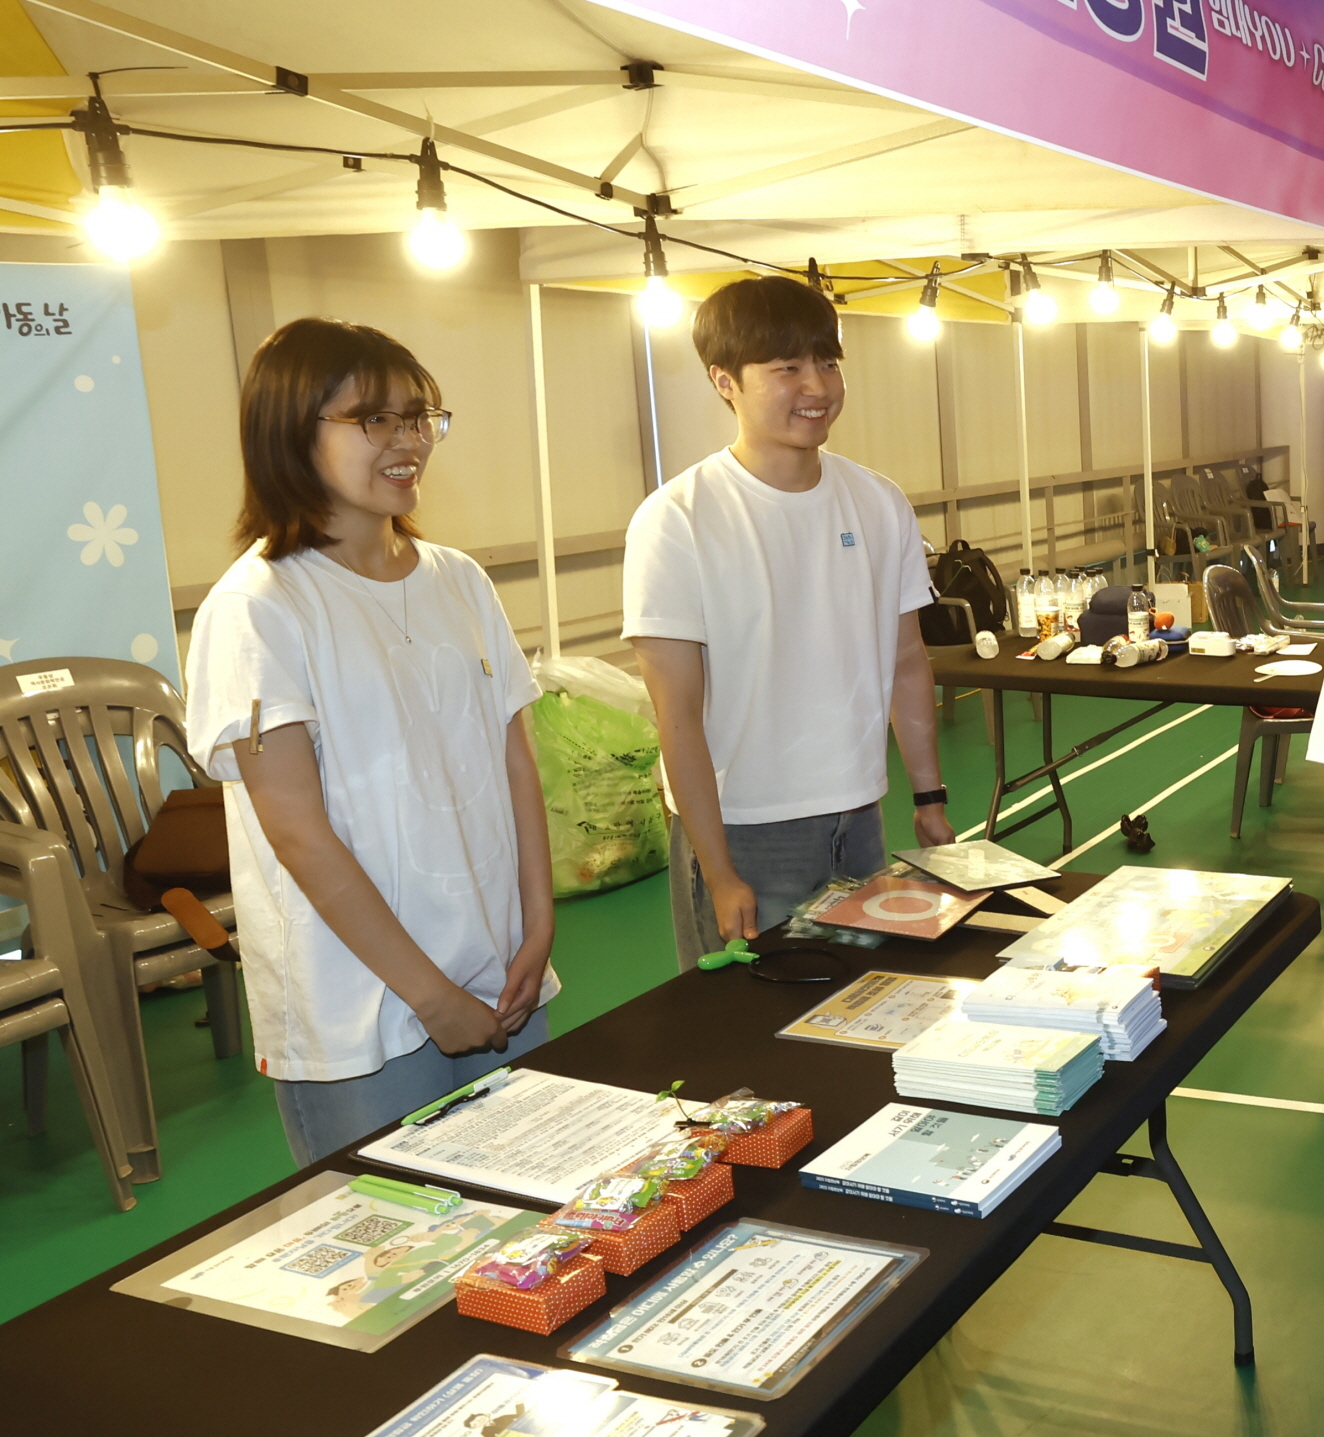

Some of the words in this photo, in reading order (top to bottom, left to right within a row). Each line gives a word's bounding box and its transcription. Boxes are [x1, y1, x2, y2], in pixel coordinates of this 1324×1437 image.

[888, 1124, 907, 1137] 서기
[634, 1291, 666, 1317] 어디에
[666, 1269, 697, 1293] 사용할
[696, 1260, 707, 1270] 수
[704, 1233, 739, 1260] 있나요?
